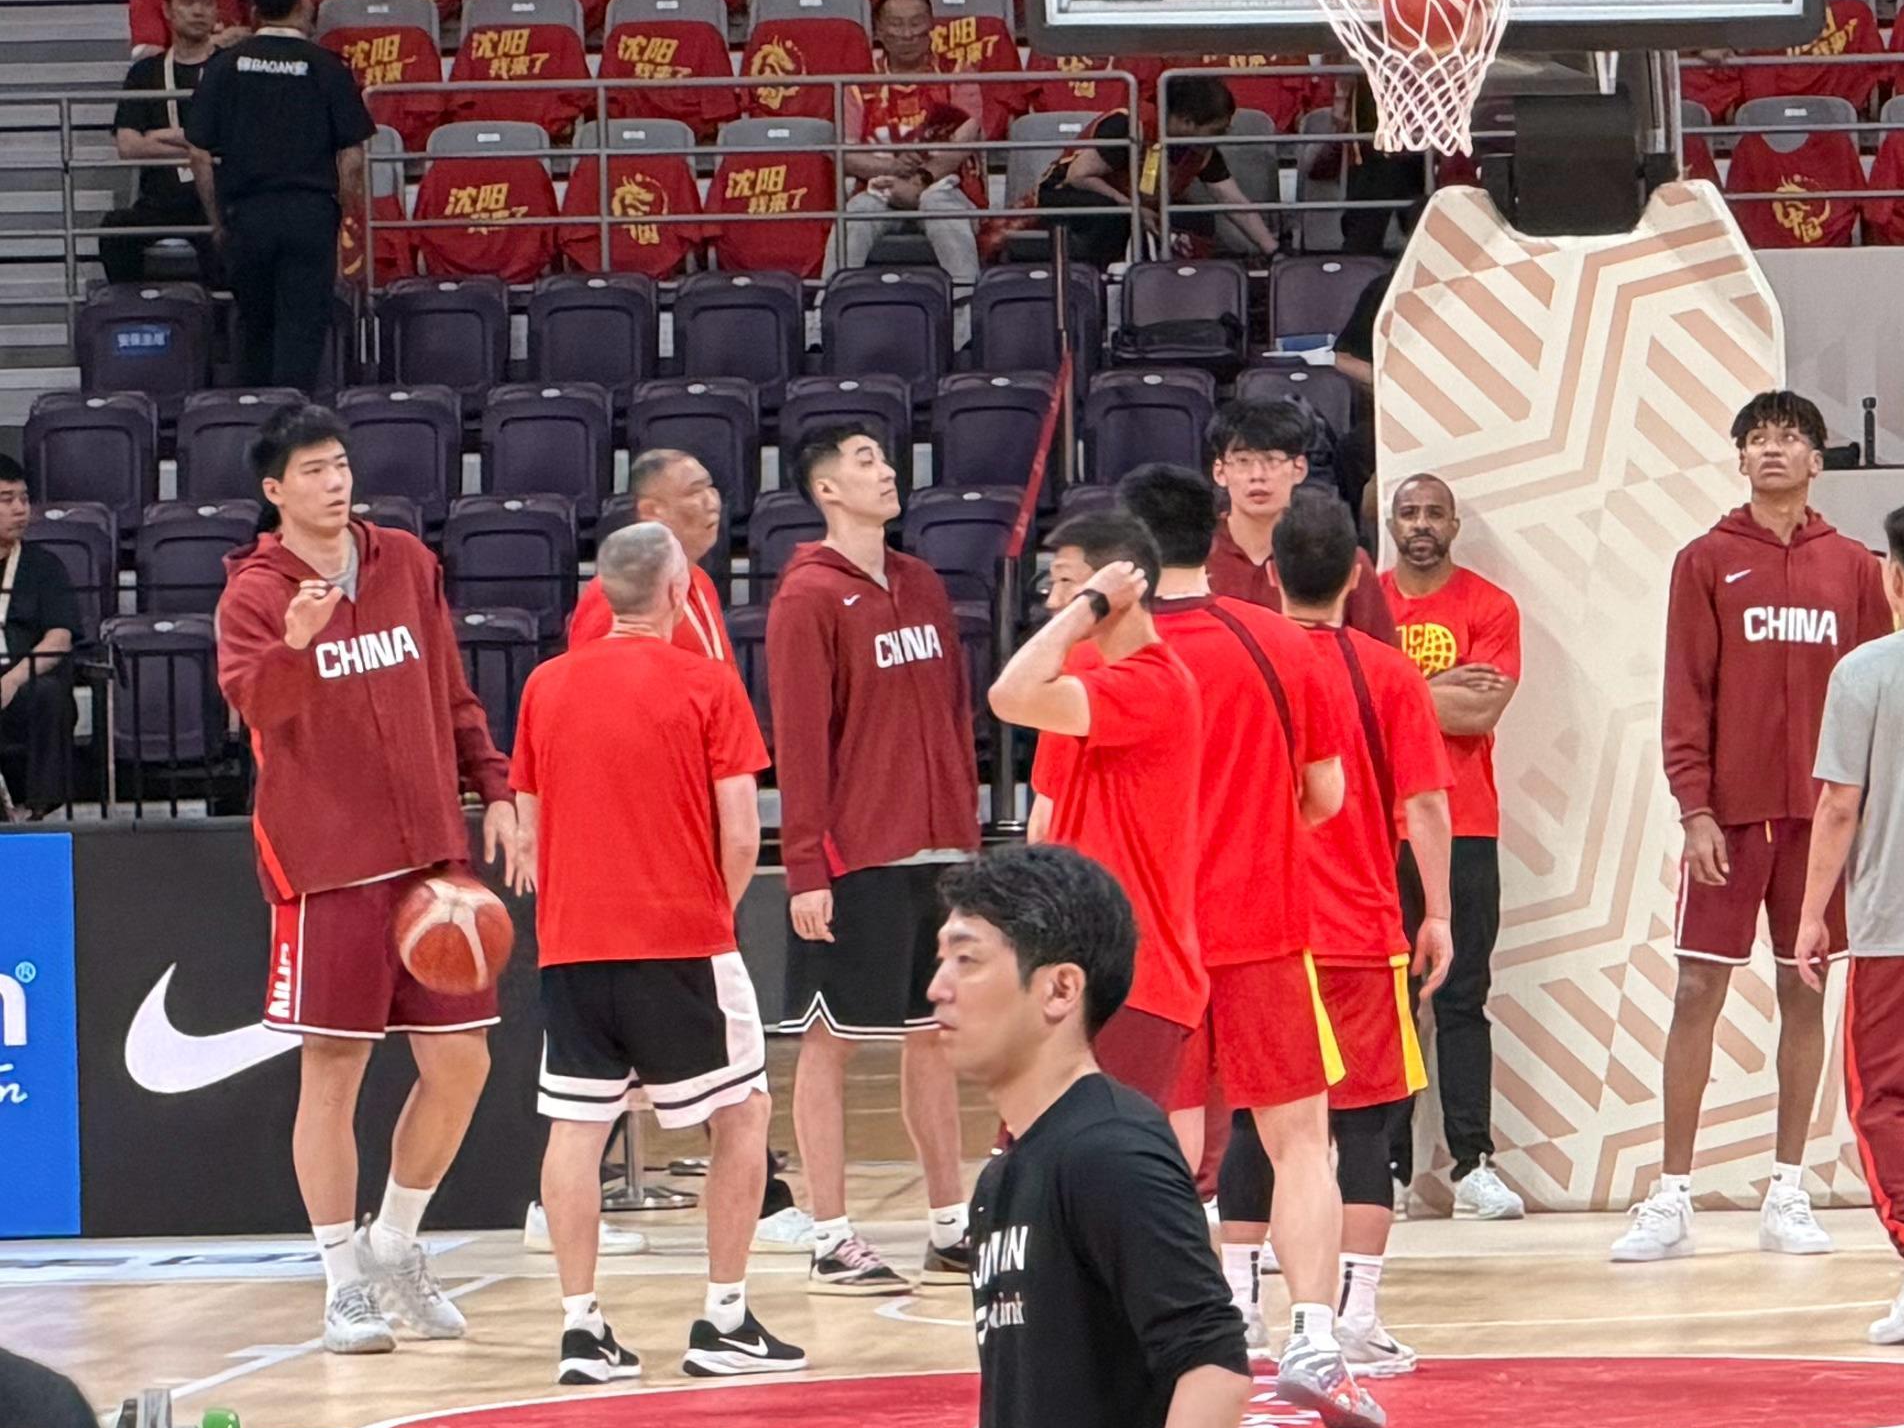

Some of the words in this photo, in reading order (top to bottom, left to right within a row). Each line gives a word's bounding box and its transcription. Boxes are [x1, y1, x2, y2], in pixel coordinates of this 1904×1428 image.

[472, 28, 530, 59] 沈阳
[727, 166, 786, 199] 沈阳
[1742, 606, 1838, 646] CHINA
[315, 625, 421, 679] CHINA
